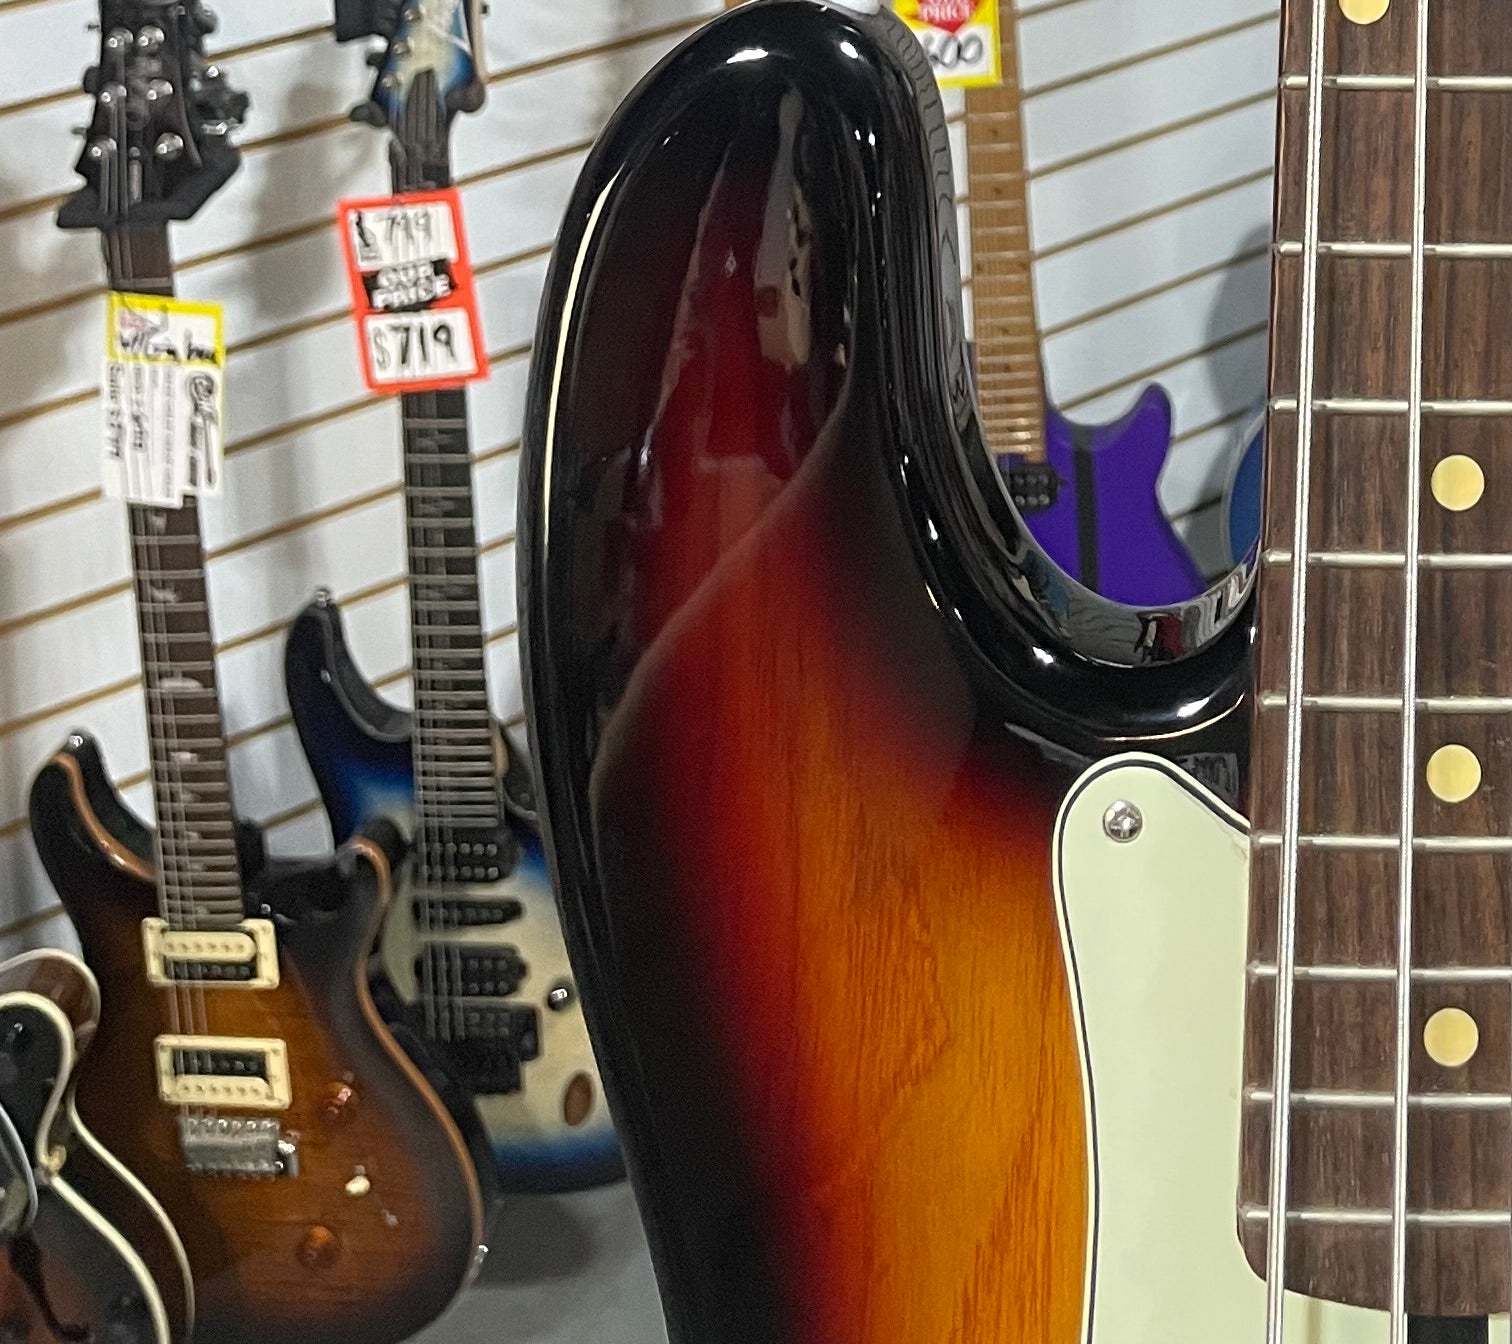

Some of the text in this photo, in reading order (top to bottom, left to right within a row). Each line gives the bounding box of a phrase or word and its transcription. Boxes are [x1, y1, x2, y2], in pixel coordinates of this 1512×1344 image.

[919, 2, 972, 22] PRICE
[376, 261, 435, 290] OUR
[371, 274, 451, 311] PRICE
